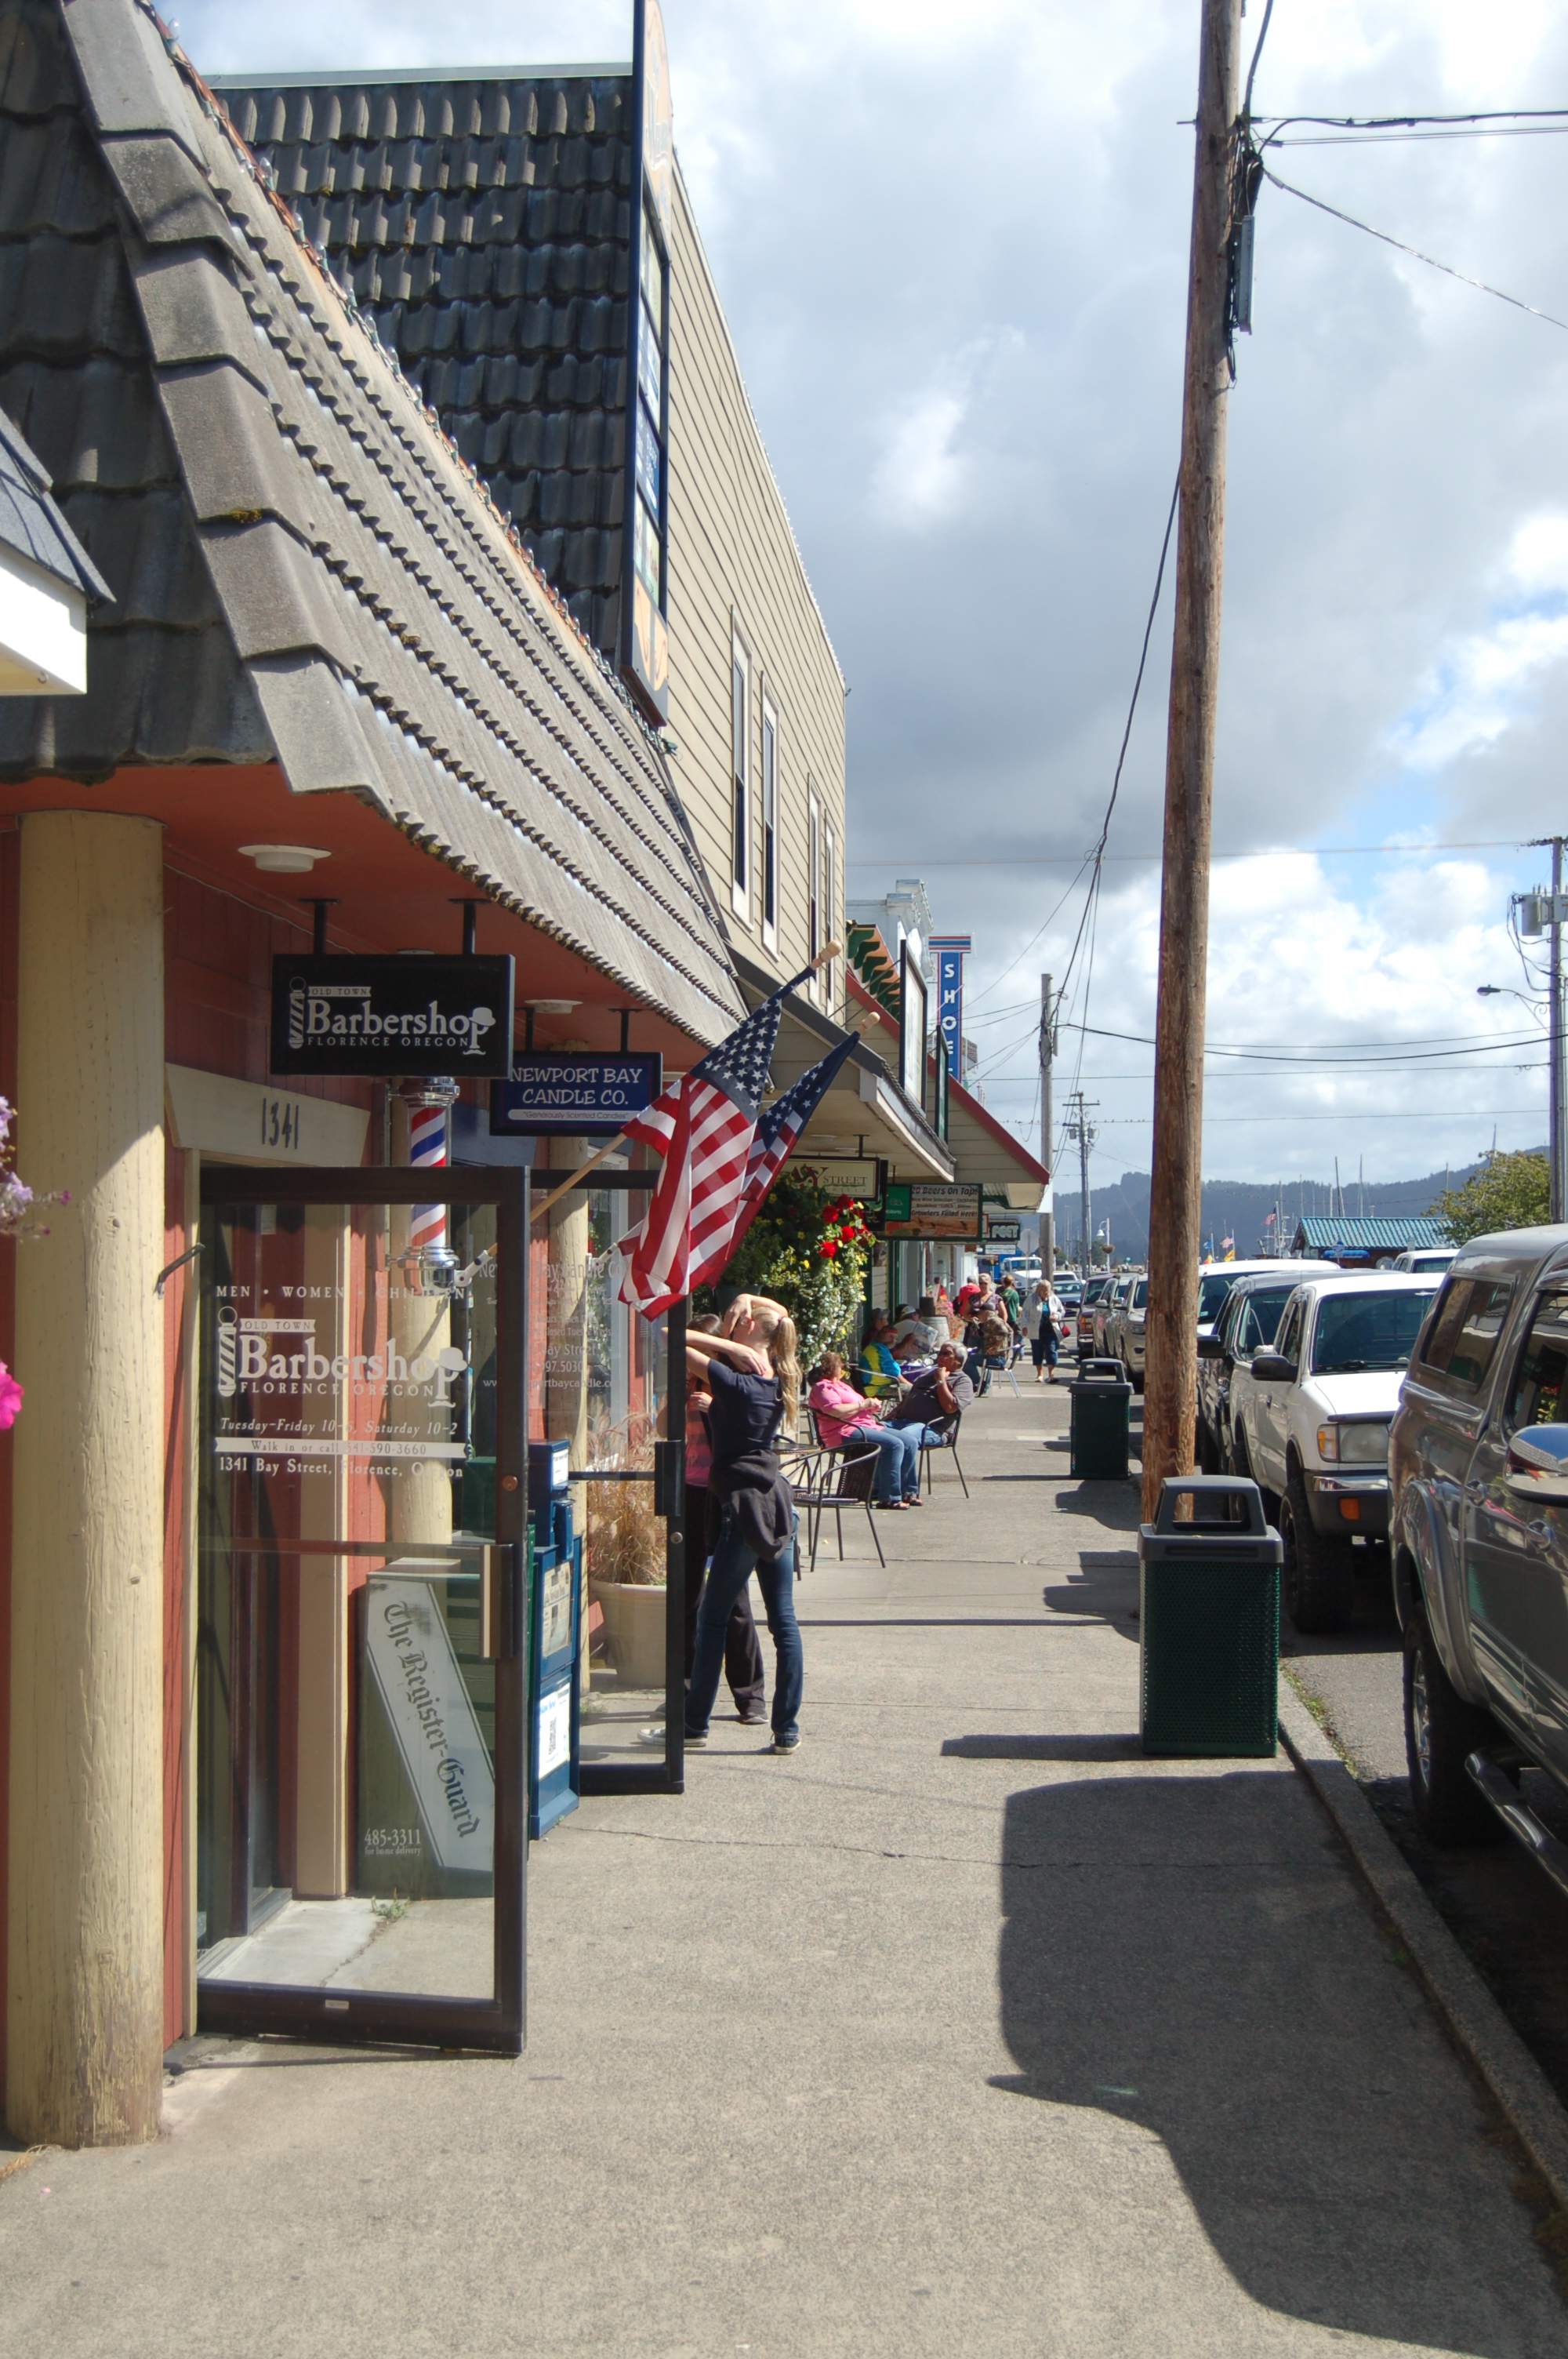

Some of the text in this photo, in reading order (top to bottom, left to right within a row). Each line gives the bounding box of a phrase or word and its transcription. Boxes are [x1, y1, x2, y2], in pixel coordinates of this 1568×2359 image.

[307, 999, 491, 1049] Barbershop
[307, 1037, 469, 1047] FLORENCE OREGON
[510, 1067, 643, 1083] NEWPORT BAY
[522, 1089, 629, 1105] CANDLE CO.
[261, 1097, 299, 1150] 1341
[823, 1176, 868, 1185] STREET
[947, 1187, 959, 1195] On
[960, 1187, 978, 1197] Tap!
[991, 1224, 1019, 1238] FEET
[216, 1285, 466, 1300] MEN WOMEN CHILDREN
[245, 1321, 311, 1330] OLD TOWN
[564, 1343, 597, 1355] Street
[239, 1335, 461, 1400] Barbershop
[240, 1381, 434, 1397] FLORENCE OREGON
[365, 1419, 420, 1438] Saturday
[251, 1440, 278, 1452] Walk
[285, 1443, 296, 1452] in
[319, 1443, 339, 1452] call
[347, 1442, 426, 1455] 541-590-3660
[220, 1456, 248, 1471] 1341
[256, 1458, 280, 1477] Bay
[286, 1458, 332, 1475] Street,
[341, 1459, 403, 1478] Florence,
[383, 1601, 481, 1838] The Register-Guard
[364, 1826, 422, 1847] 485-3311
[365, 1845, 422, 1857] for home delivery
